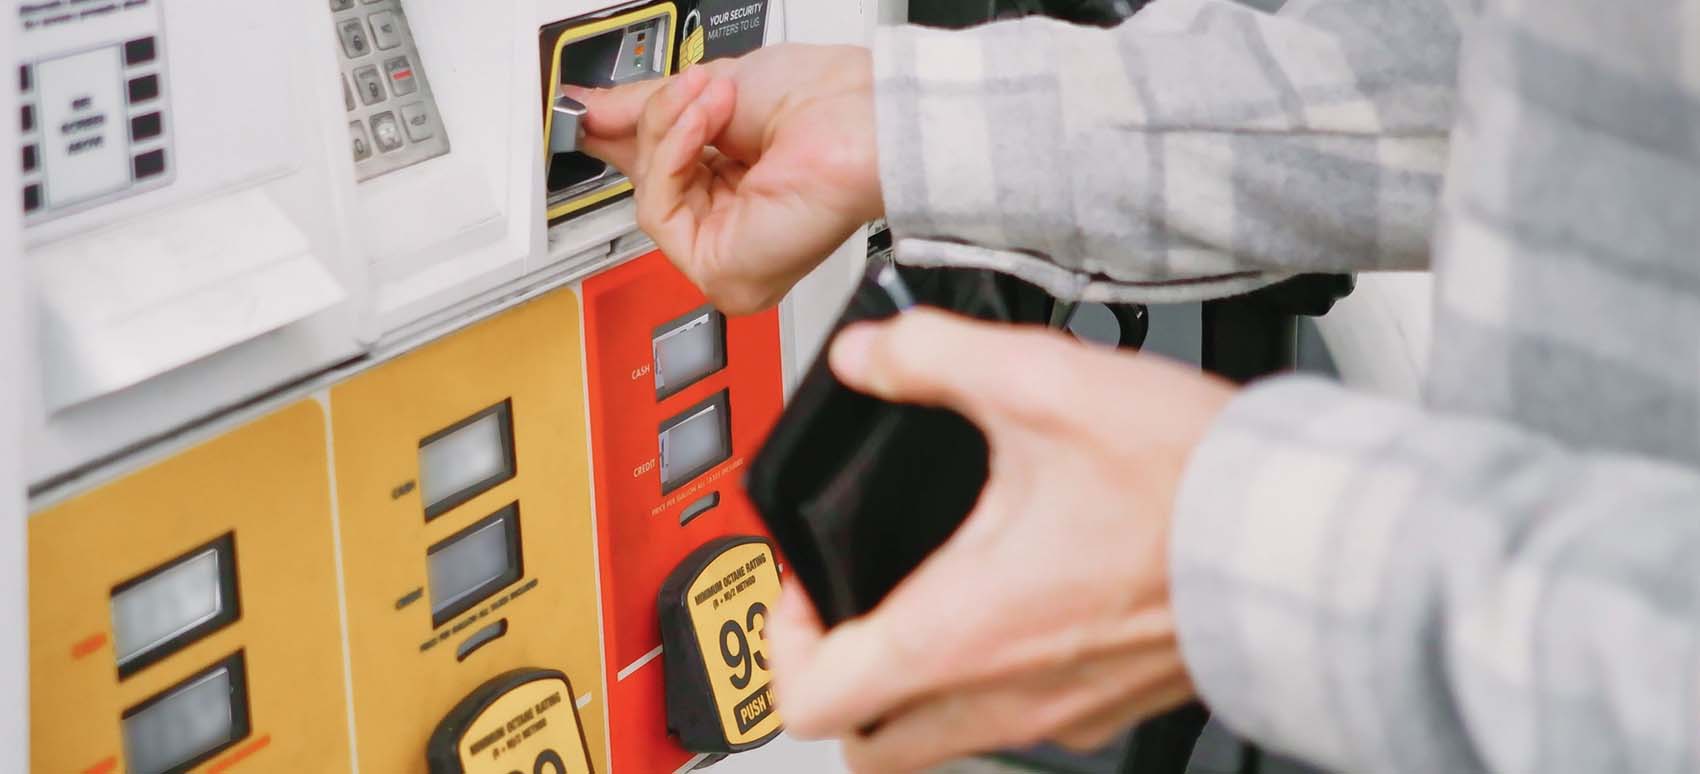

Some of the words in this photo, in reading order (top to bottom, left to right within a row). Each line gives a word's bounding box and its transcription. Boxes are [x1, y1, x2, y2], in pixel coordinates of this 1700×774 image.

[710, 12, 730, 27] YOUR
[730, 2, 763, 21] SECURITY
[708, 22, 739, 40] MATTERS
[740, 20, 749, 31] TO
[631, 364, 650, 380] CASH
[633, 458, 656, 478] CREDIT
[694, 580, 723, 606] MINIMUM
[723, 566, 746, 588] OCTANE
[746, 552, 767, 573] RATING
[735, 575, 756, 594] METHOD
[719, 602, 769, 690] 93
[740, 694, 767, 725] PUSH
